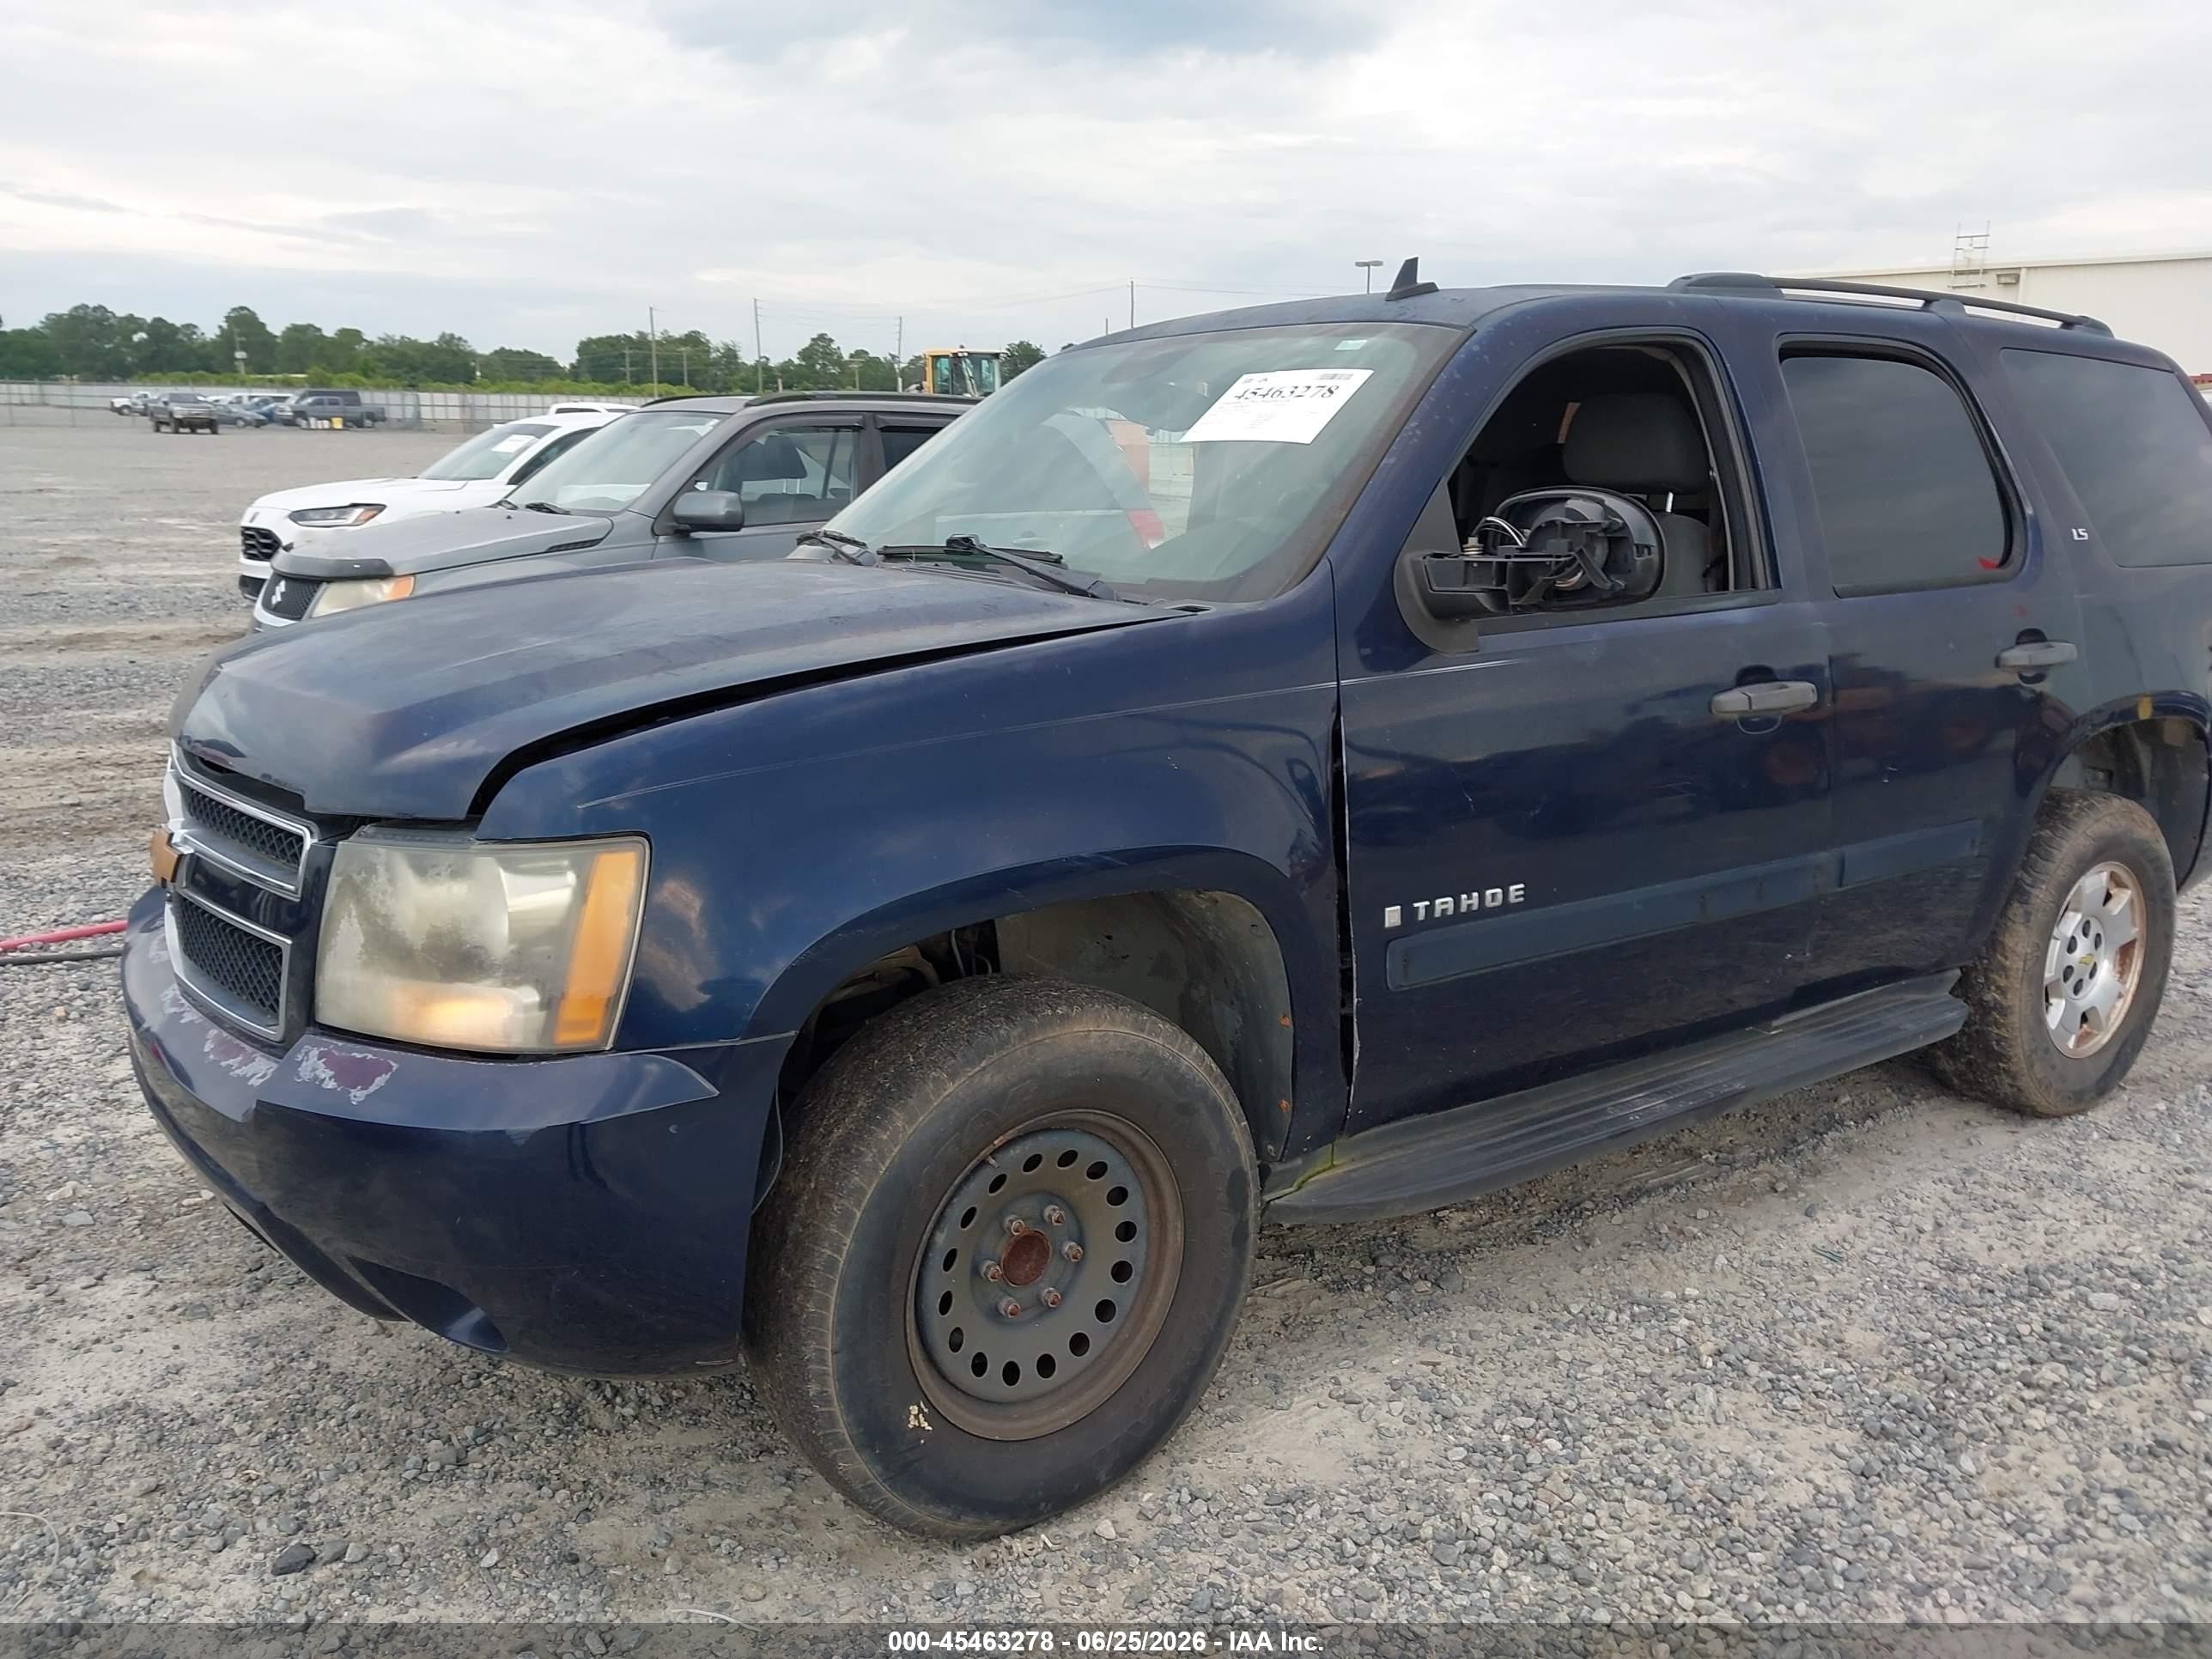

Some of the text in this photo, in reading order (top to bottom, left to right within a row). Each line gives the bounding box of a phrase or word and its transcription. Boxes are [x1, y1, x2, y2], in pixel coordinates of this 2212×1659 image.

[1234, 385, 1340, 399] 45463278
[2071, 528, 2089, 541] LS
[1413, 884, 1526, 921] TAHOE
